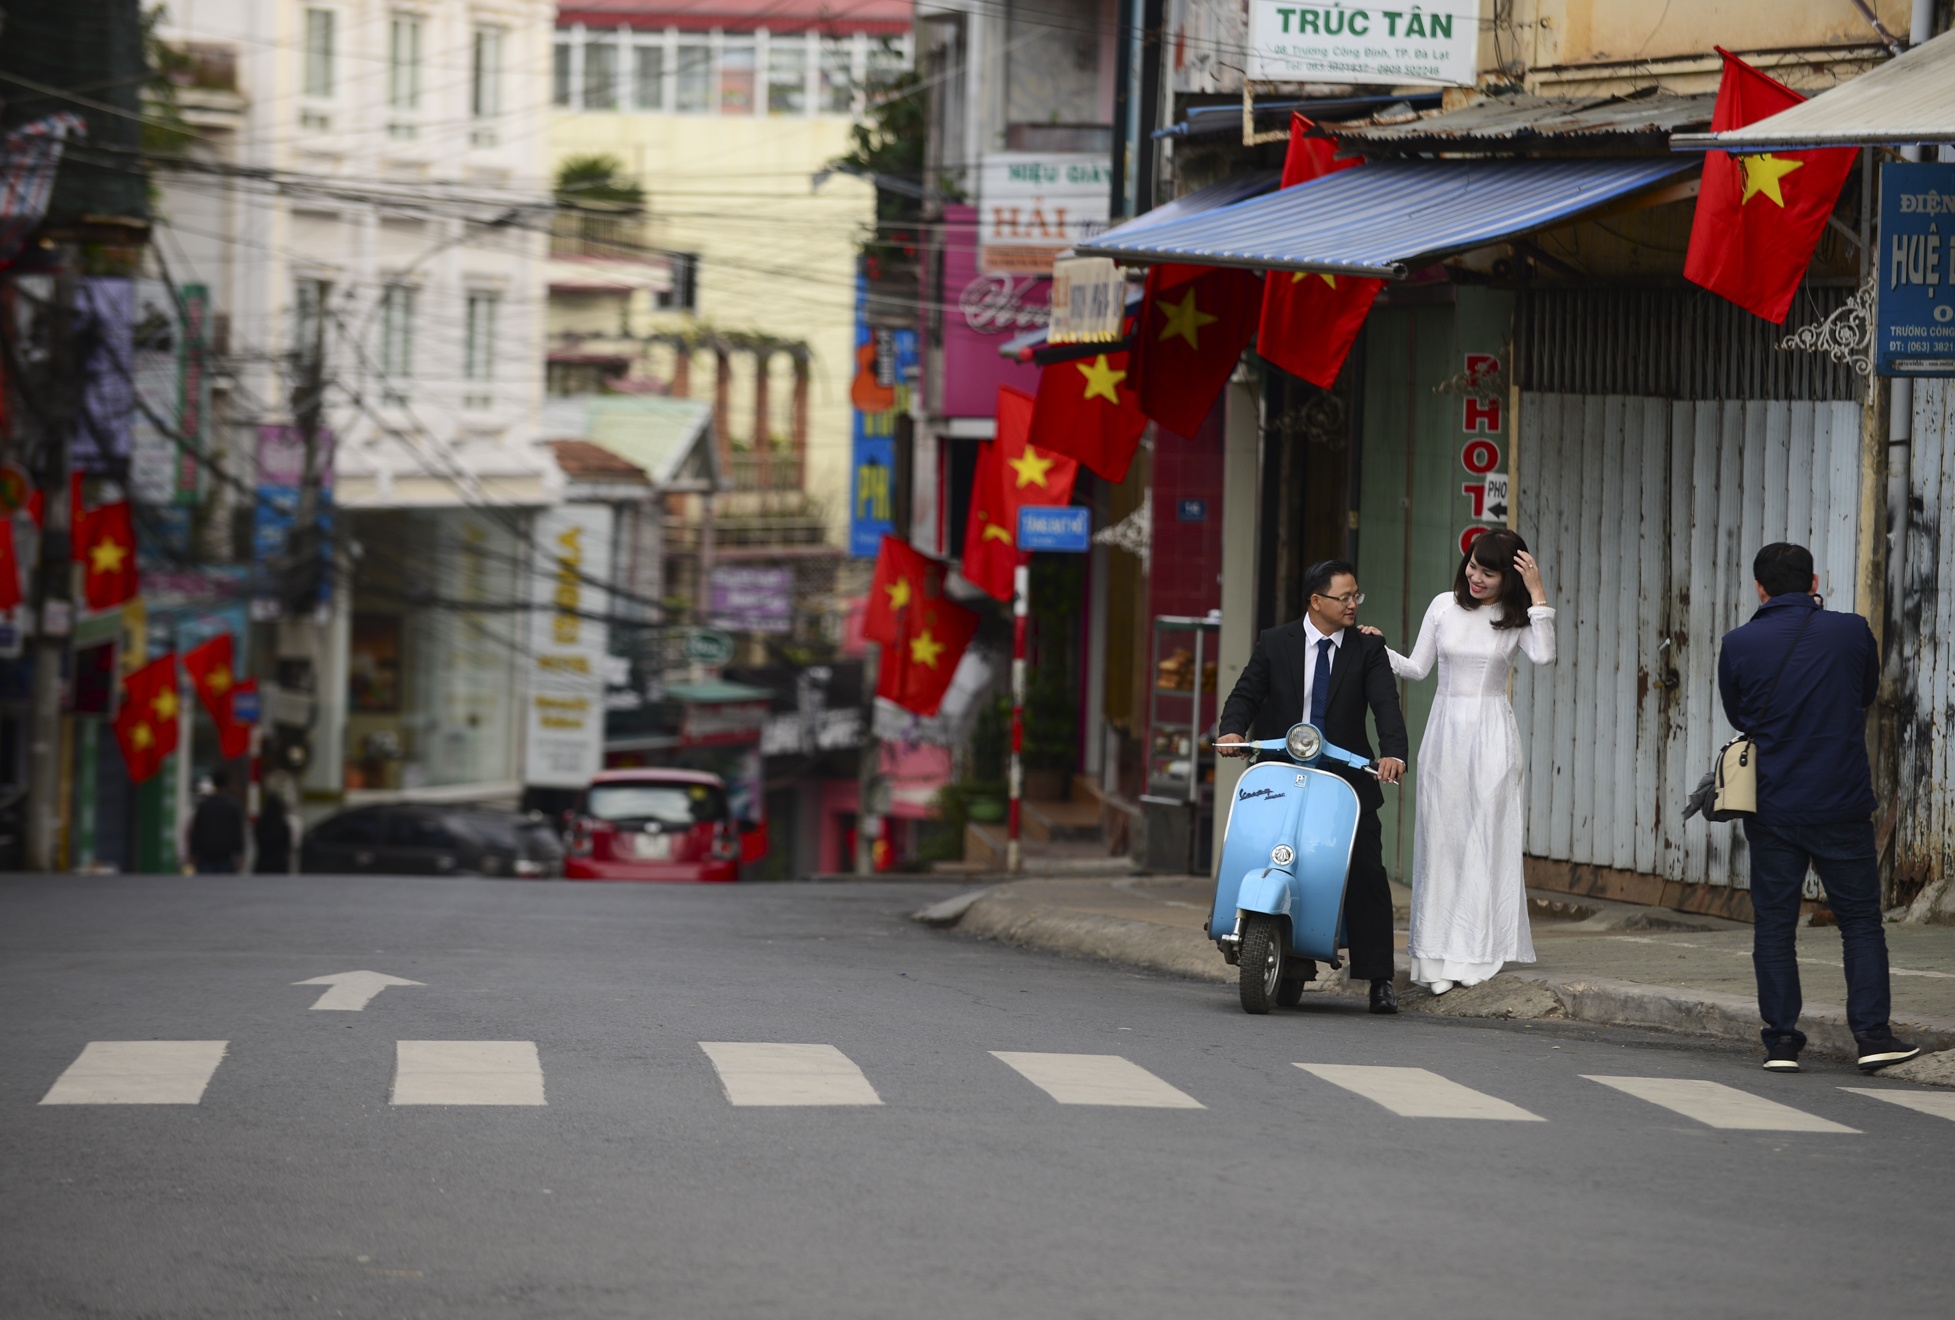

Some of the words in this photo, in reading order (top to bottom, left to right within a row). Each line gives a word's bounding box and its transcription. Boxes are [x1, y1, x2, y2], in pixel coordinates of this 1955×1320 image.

[1276, 2, 1370, 37] TRÚC
[1382, 5, 1453, 39] TÂN
[1891, 222, 1941, 298] HUỆ
[1933, 341, 1955, 352] 3821
[1239, 788, 1274, 802] Vespa
